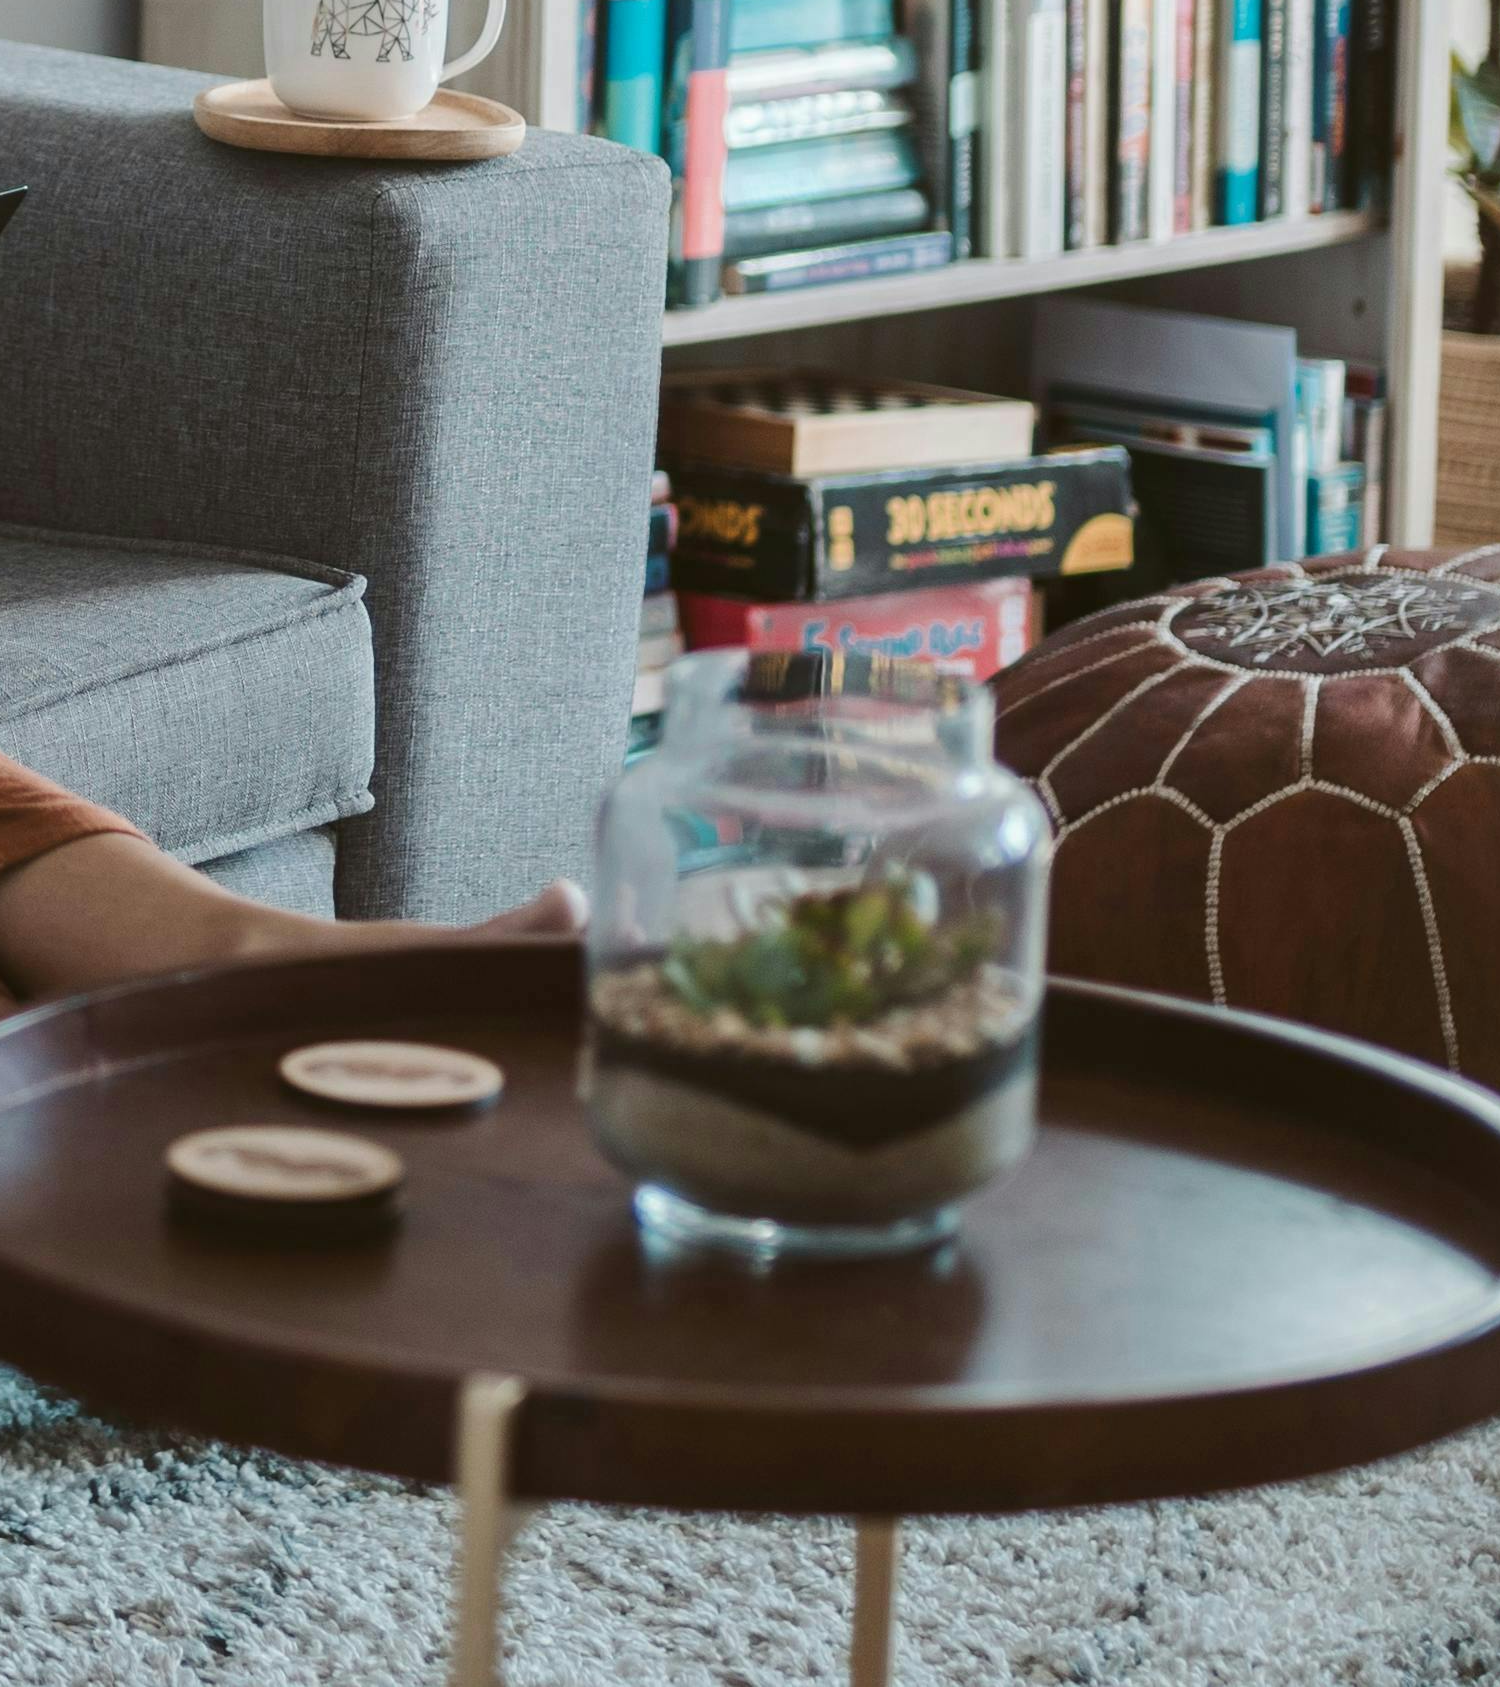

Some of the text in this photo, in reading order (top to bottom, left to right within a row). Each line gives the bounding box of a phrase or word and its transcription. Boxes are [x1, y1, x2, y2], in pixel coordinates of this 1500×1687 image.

[678, 496, 765, 545] ONDS
[886, 480, 1057, 546] 30 SECONDS
